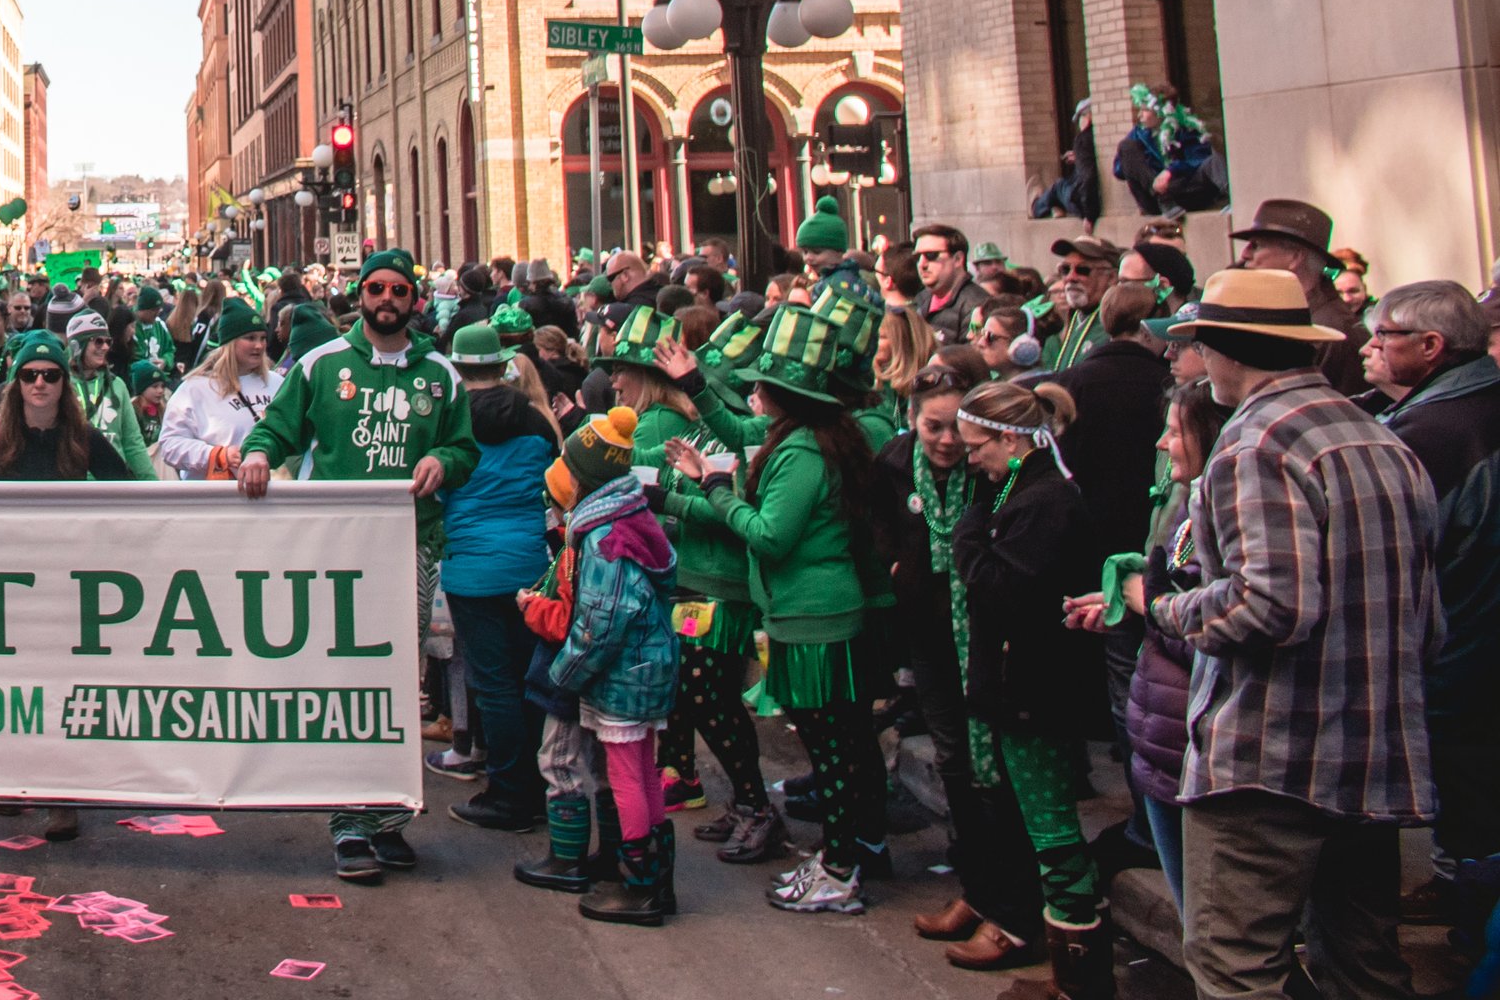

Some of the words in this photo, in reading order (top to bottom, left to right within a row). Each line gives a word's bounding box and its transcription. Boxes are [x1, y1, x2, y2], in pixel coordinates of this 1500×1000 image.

[550, 25, 609, 48] SIBLEY
[622, 29, 634, 39] ST
[615, 42, 632, 53] 365
[337, 235, 357, 245] ONE
[337, 245, 358, 255] WAY
[358, 388, 375, 415] I
[352, 415, 411, 447] SAINT
[365, 442, 408, 473] PAUL
[70, 569, 394, 659] PAUL
[65, 688, 403, 739] #MYSAINTPAUL
